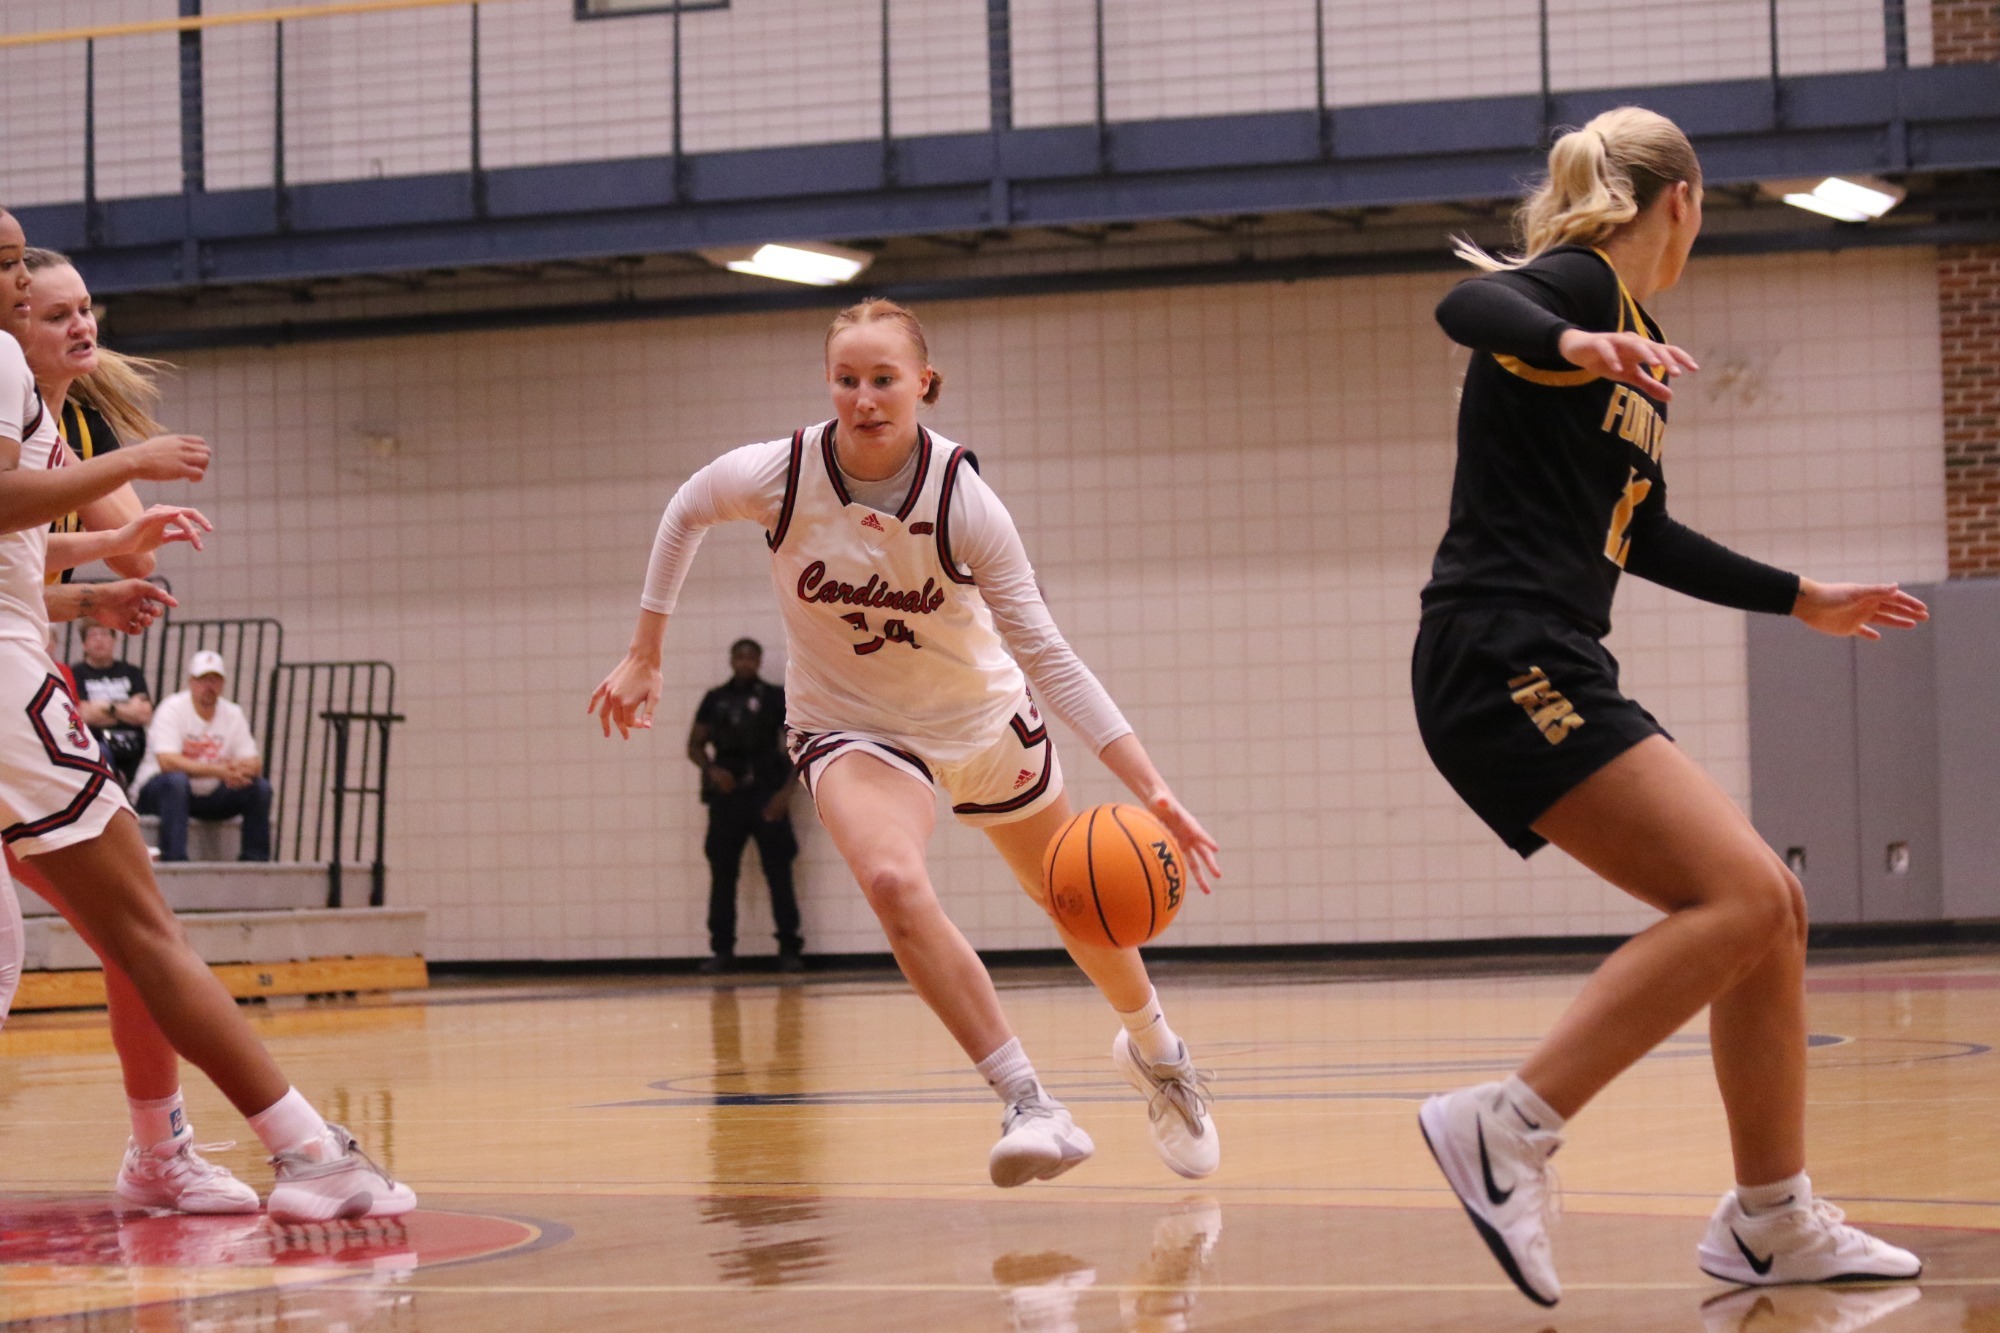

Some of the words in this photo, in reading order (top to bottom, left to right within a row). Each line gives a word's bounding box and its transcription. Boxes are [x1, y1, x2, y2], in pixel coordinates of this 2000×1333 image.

[861, 519, 885, 533] adidas
[797, 560, 945, 614] Cardinals
[1151, 839, 1181, 912] NCAA
